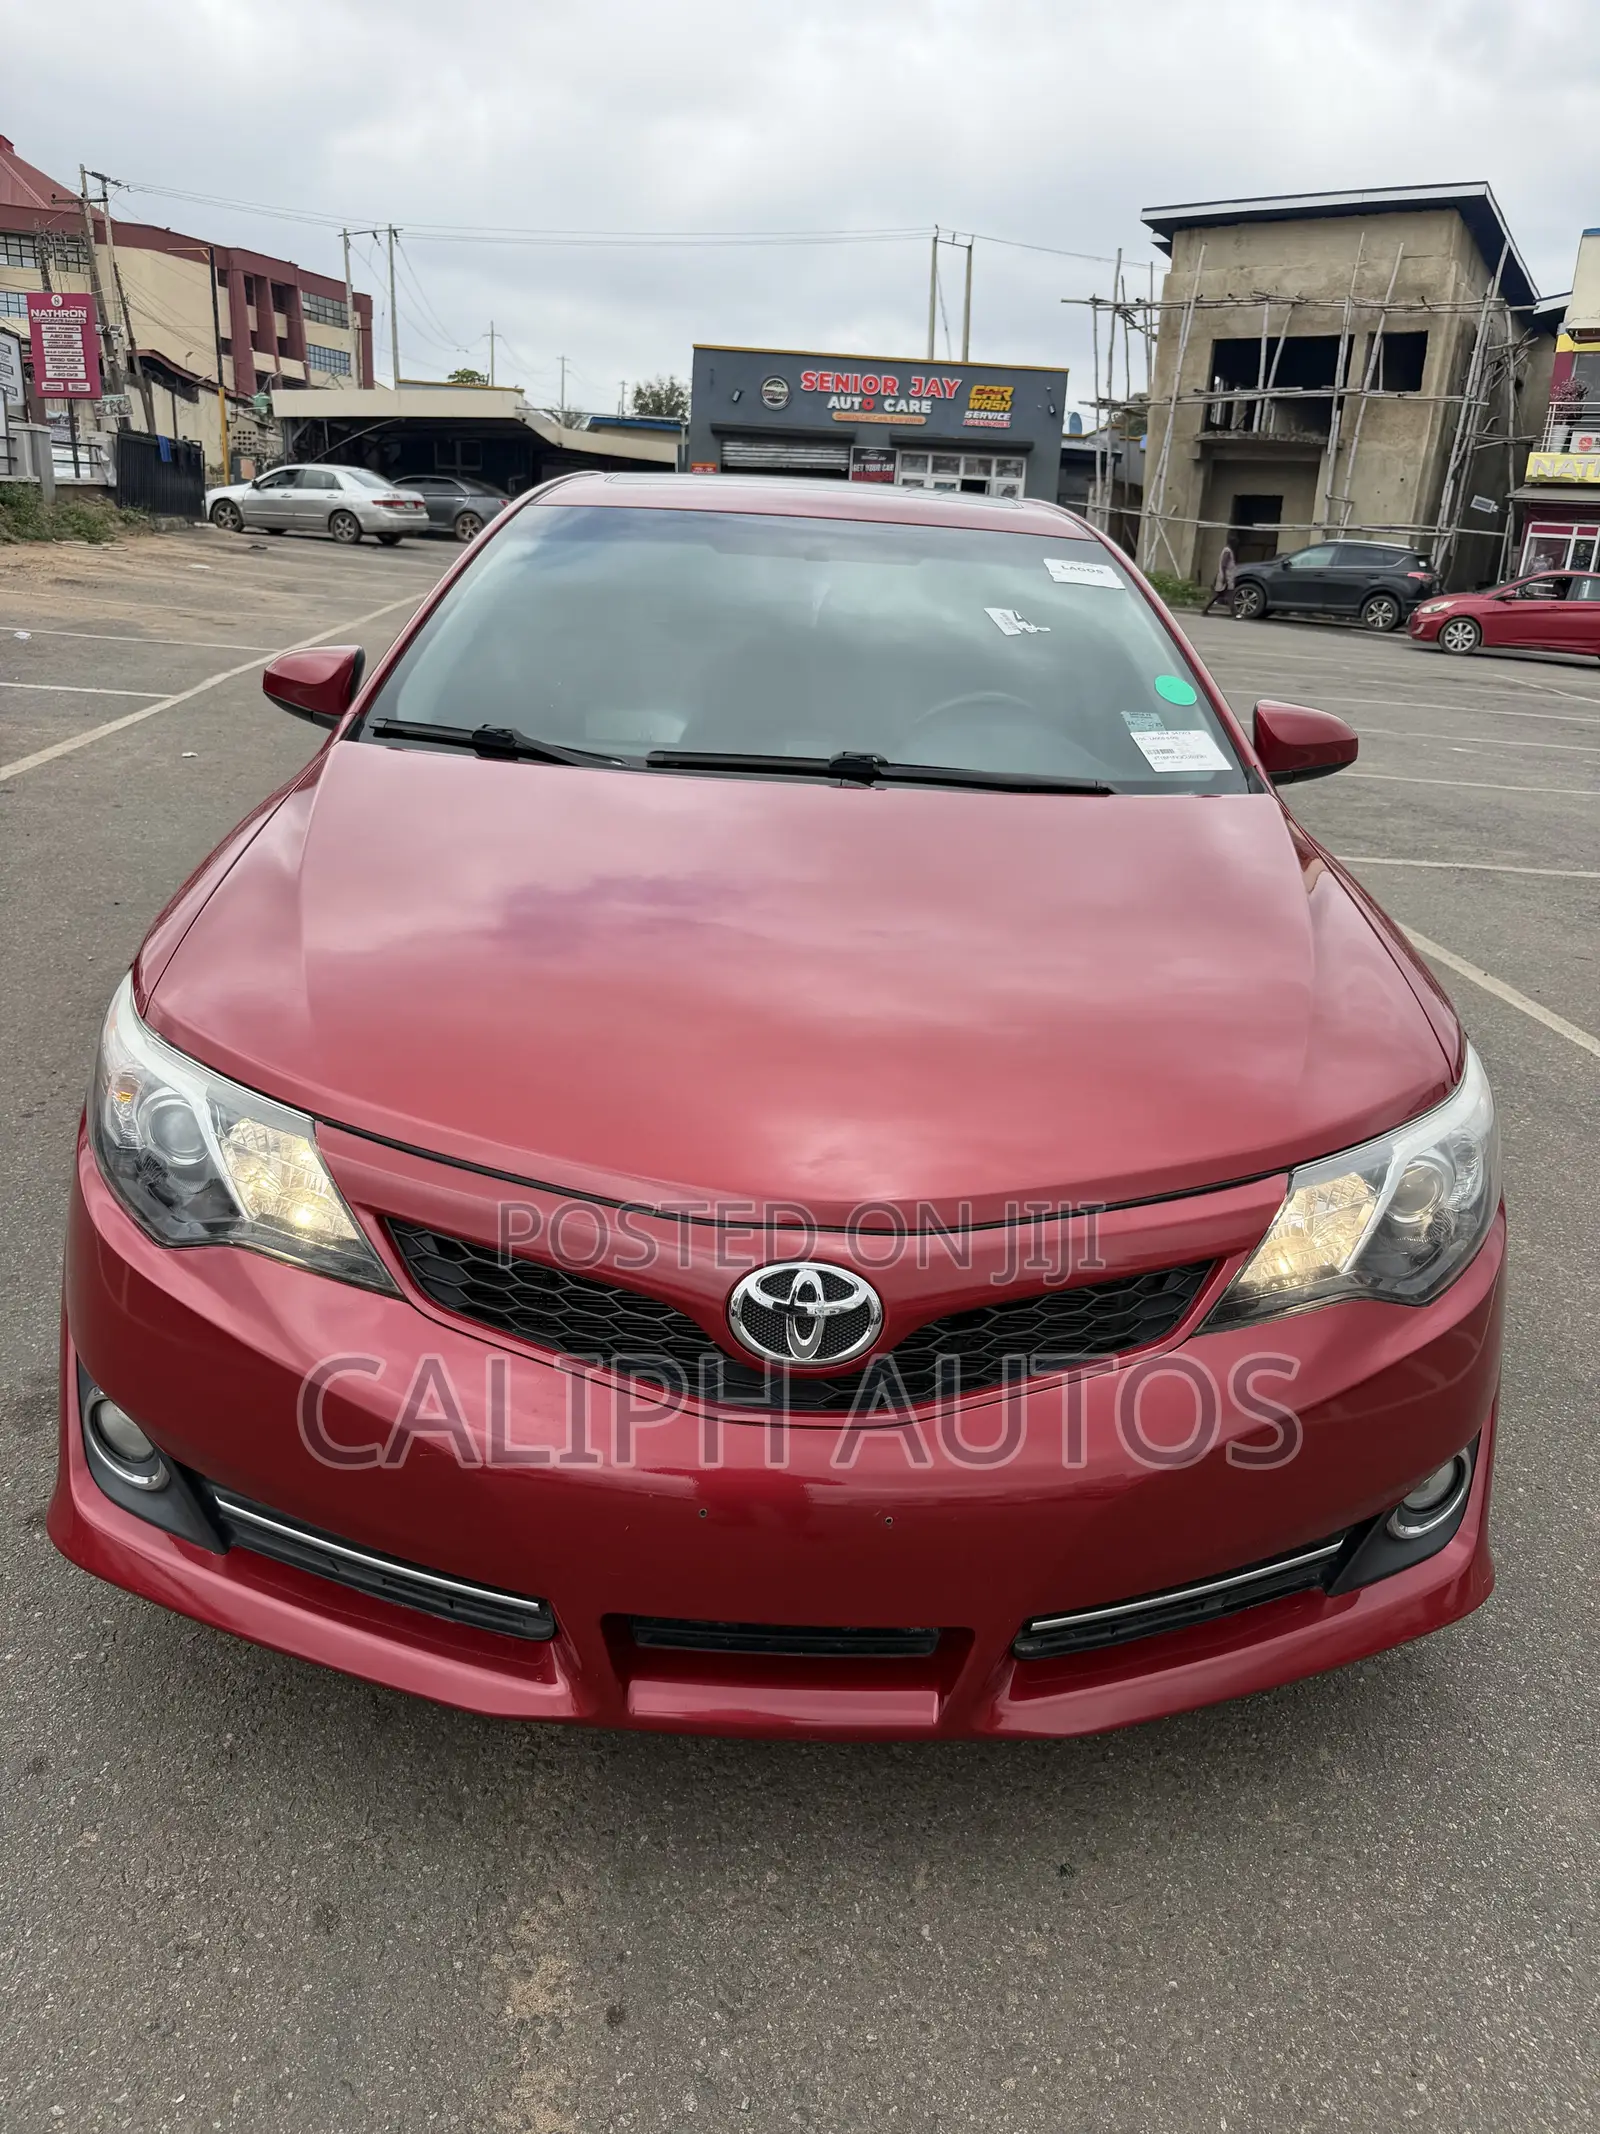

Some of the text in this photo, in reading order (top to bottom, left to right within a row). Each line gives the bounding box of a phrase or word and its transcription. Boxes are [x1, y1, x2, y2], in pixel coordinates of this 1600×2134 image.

[31, 309, 87, 318] NATHRON
[801, 371, 963, 399] SENIOR JAY
[970, 385, 1014, 400] CAR
[827, 396, 932, 413] AUTO CARE
[969, 399, 1012, 411] WASH
[964, 411, 1011, 420] SERVICE
[1061, 565, 1104, 574] LAGOS
